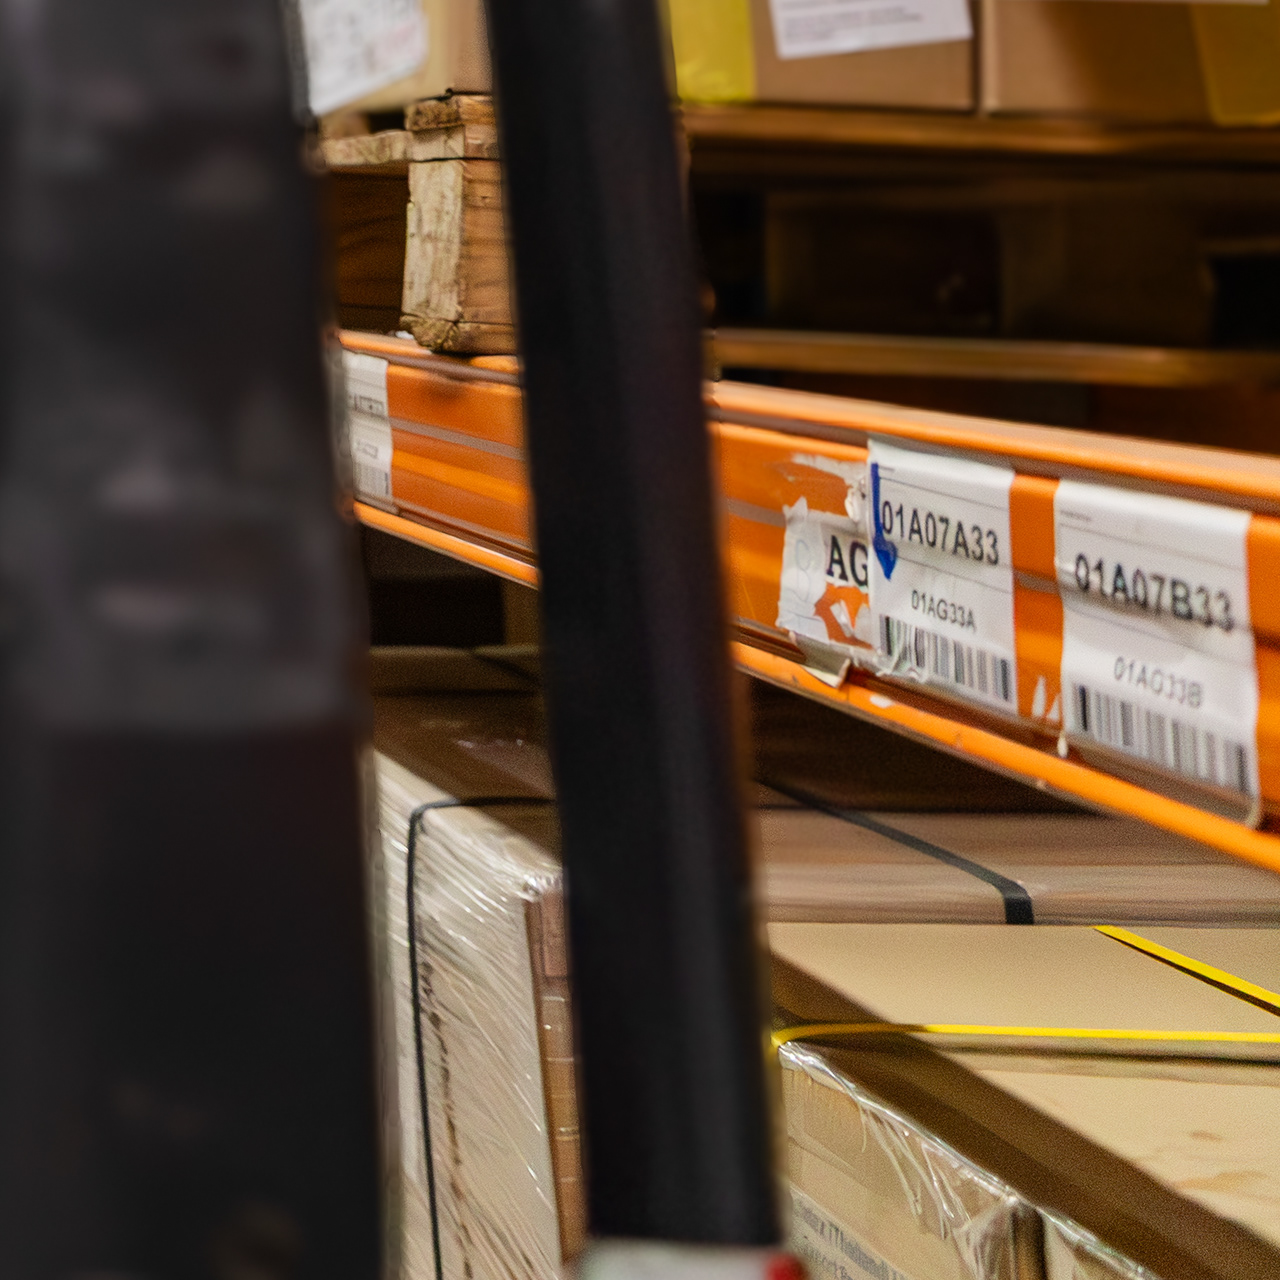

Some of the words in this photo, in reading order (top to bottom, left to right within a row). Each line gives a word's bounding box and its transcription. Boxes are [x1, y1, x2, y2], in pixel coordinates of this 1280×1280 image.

[826, 534, 868, 588] AG
[882, 500, 999, 566] 01A07A33
[911, 588, 977, 633] 01AG33A
[1075, 552, 1235, 634] 01A07B33
